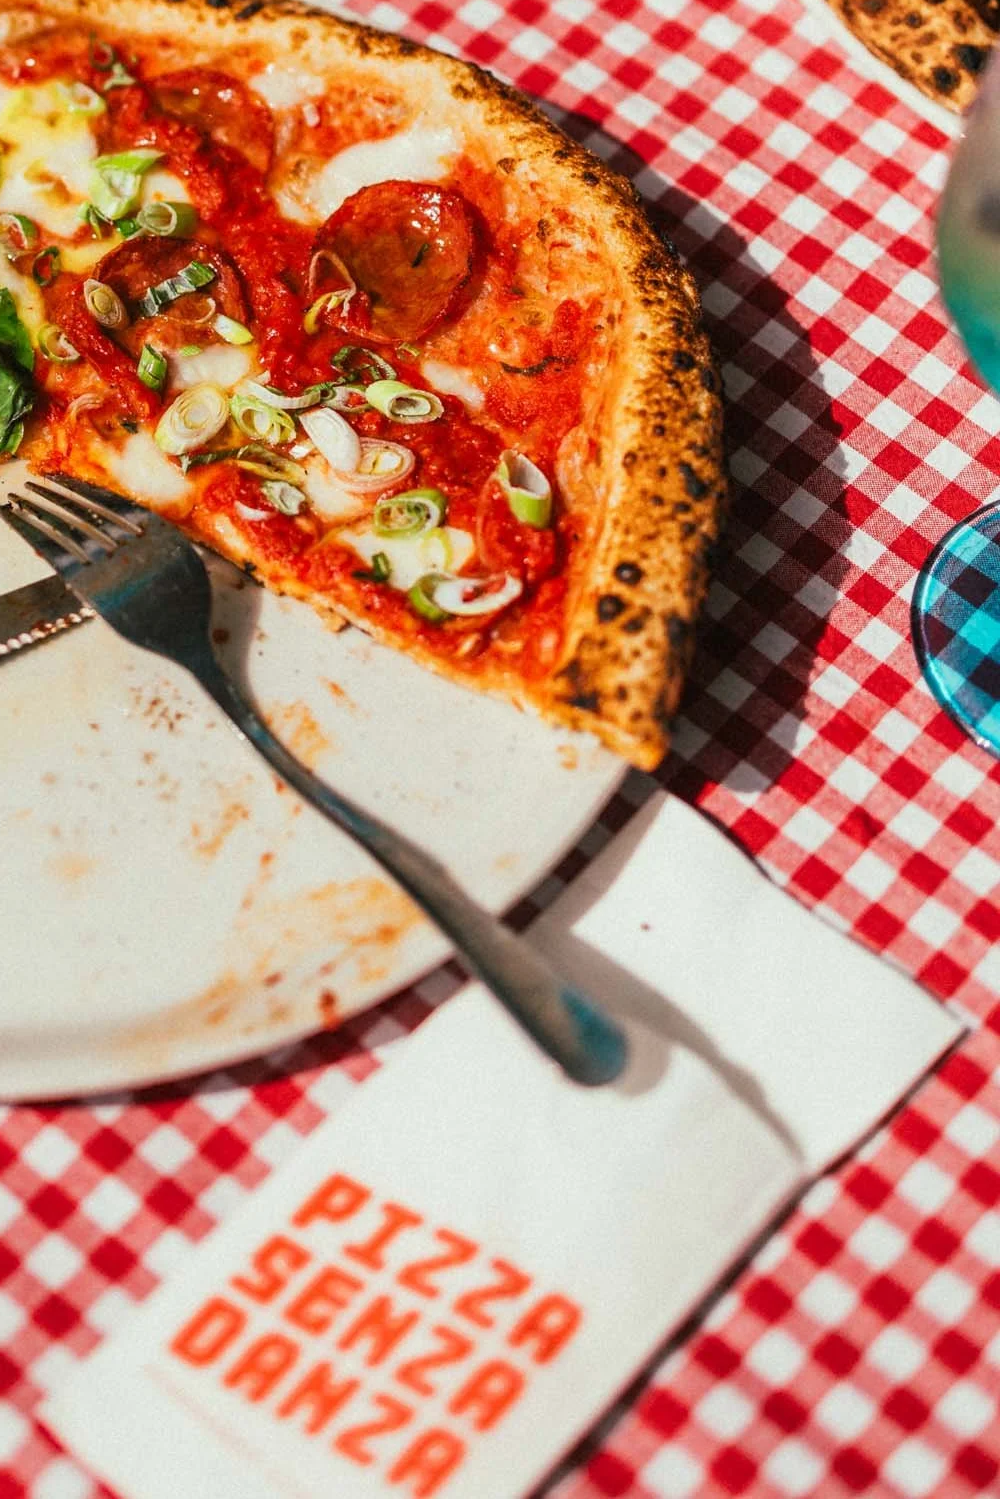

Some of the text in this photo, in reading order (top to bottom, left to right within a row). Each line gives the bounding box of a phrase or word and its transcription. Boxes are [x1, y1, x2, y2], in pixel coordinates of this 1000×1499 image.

[230, 1234, 526, 1432] SENZA
[291, 1172, 583, 1365] PIZZA
[168, 1296, 467, 1498] DANZA
